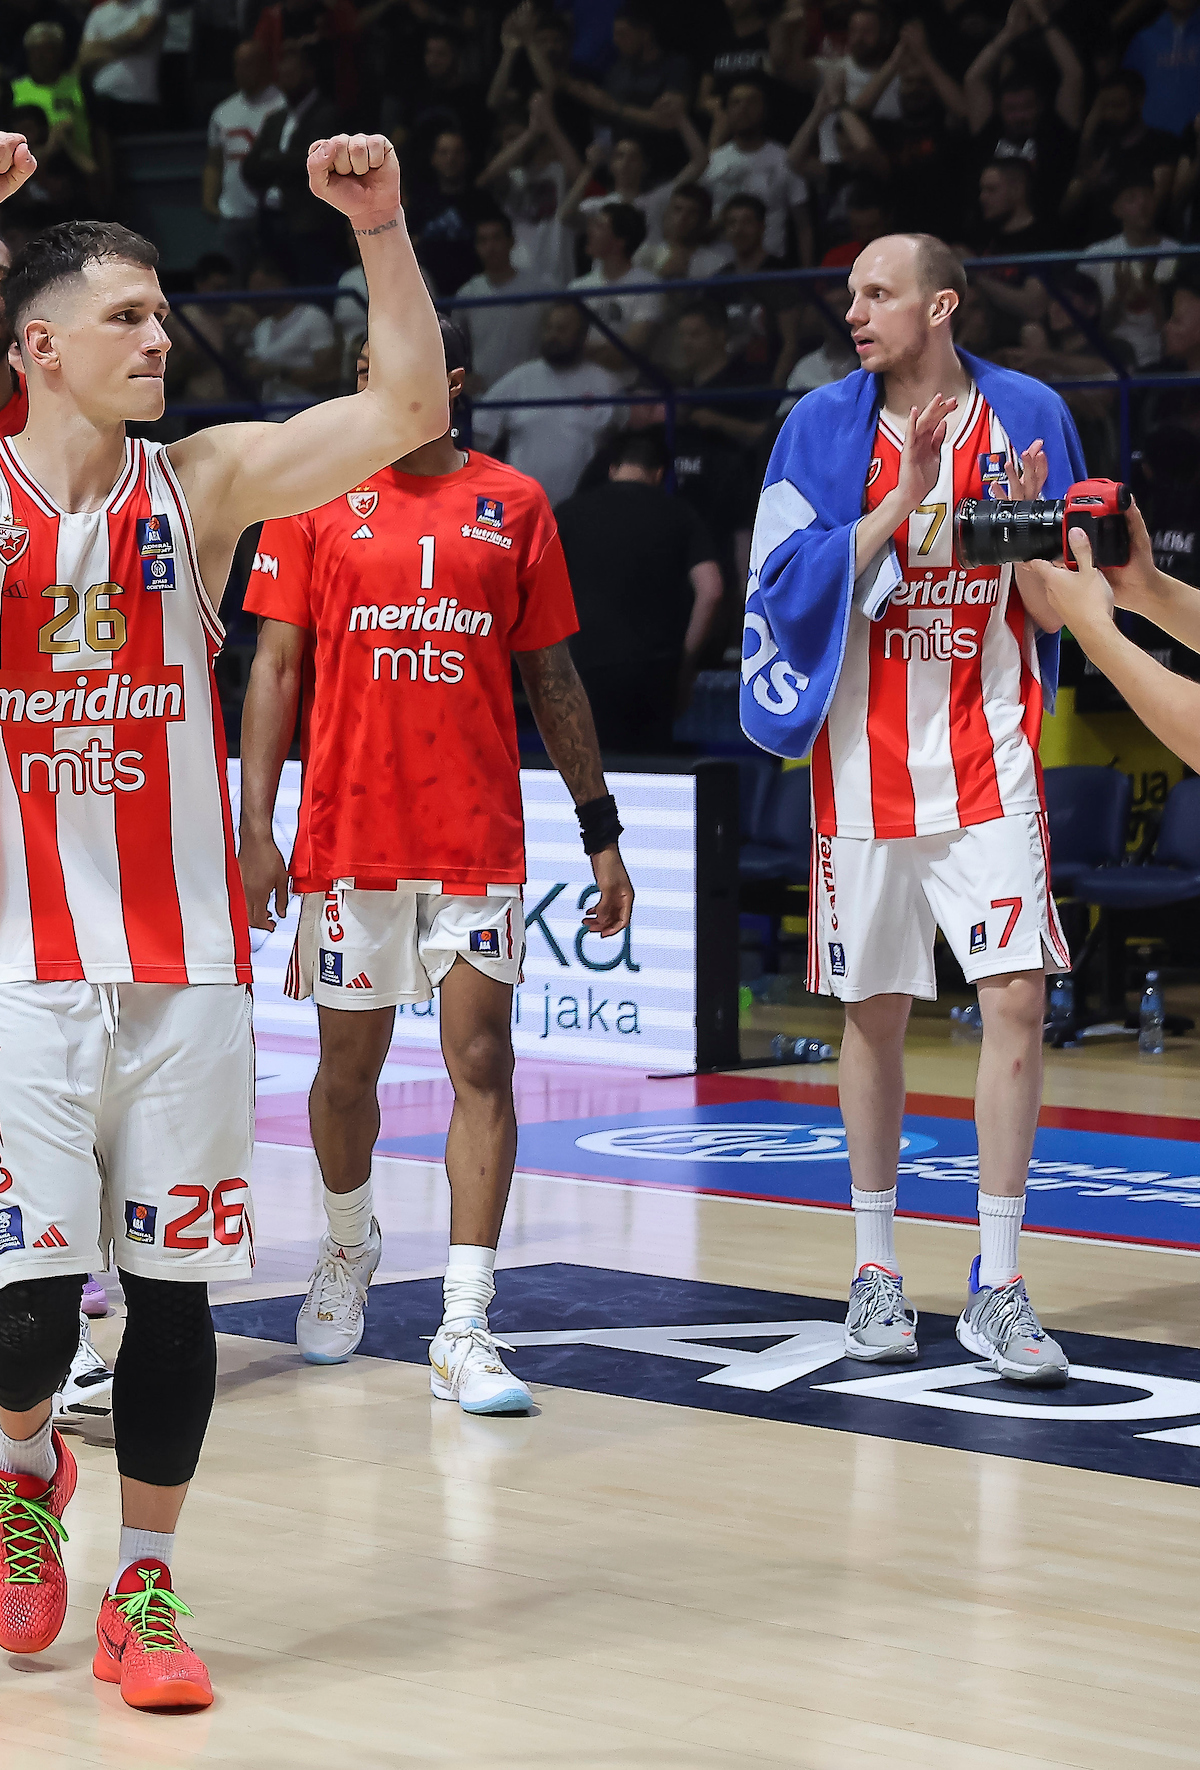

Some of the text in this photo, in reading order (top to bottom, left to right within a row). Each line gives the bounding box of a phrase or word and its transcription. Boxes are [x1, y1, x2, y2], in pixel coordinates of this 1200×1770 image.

[915, 502, 948, 556] 7
[417, 535, 436, 589] 1
[891, 570, 999, 606] eridian
[38, 581, 127, 653] 26
[348, 596, 494, 637] meridian
[884, 619, 979, 661] mts
[373, 640, 465, 684] mts
[20, 740, 146, 793] mts
[820, 835, 838, 931] carne
[525, 883, 641, 972] ka
[990, 896, 1023, 949] 7
[540, 983, 641, 1038] jaka
[163, 1177, 249, 1250] 26
